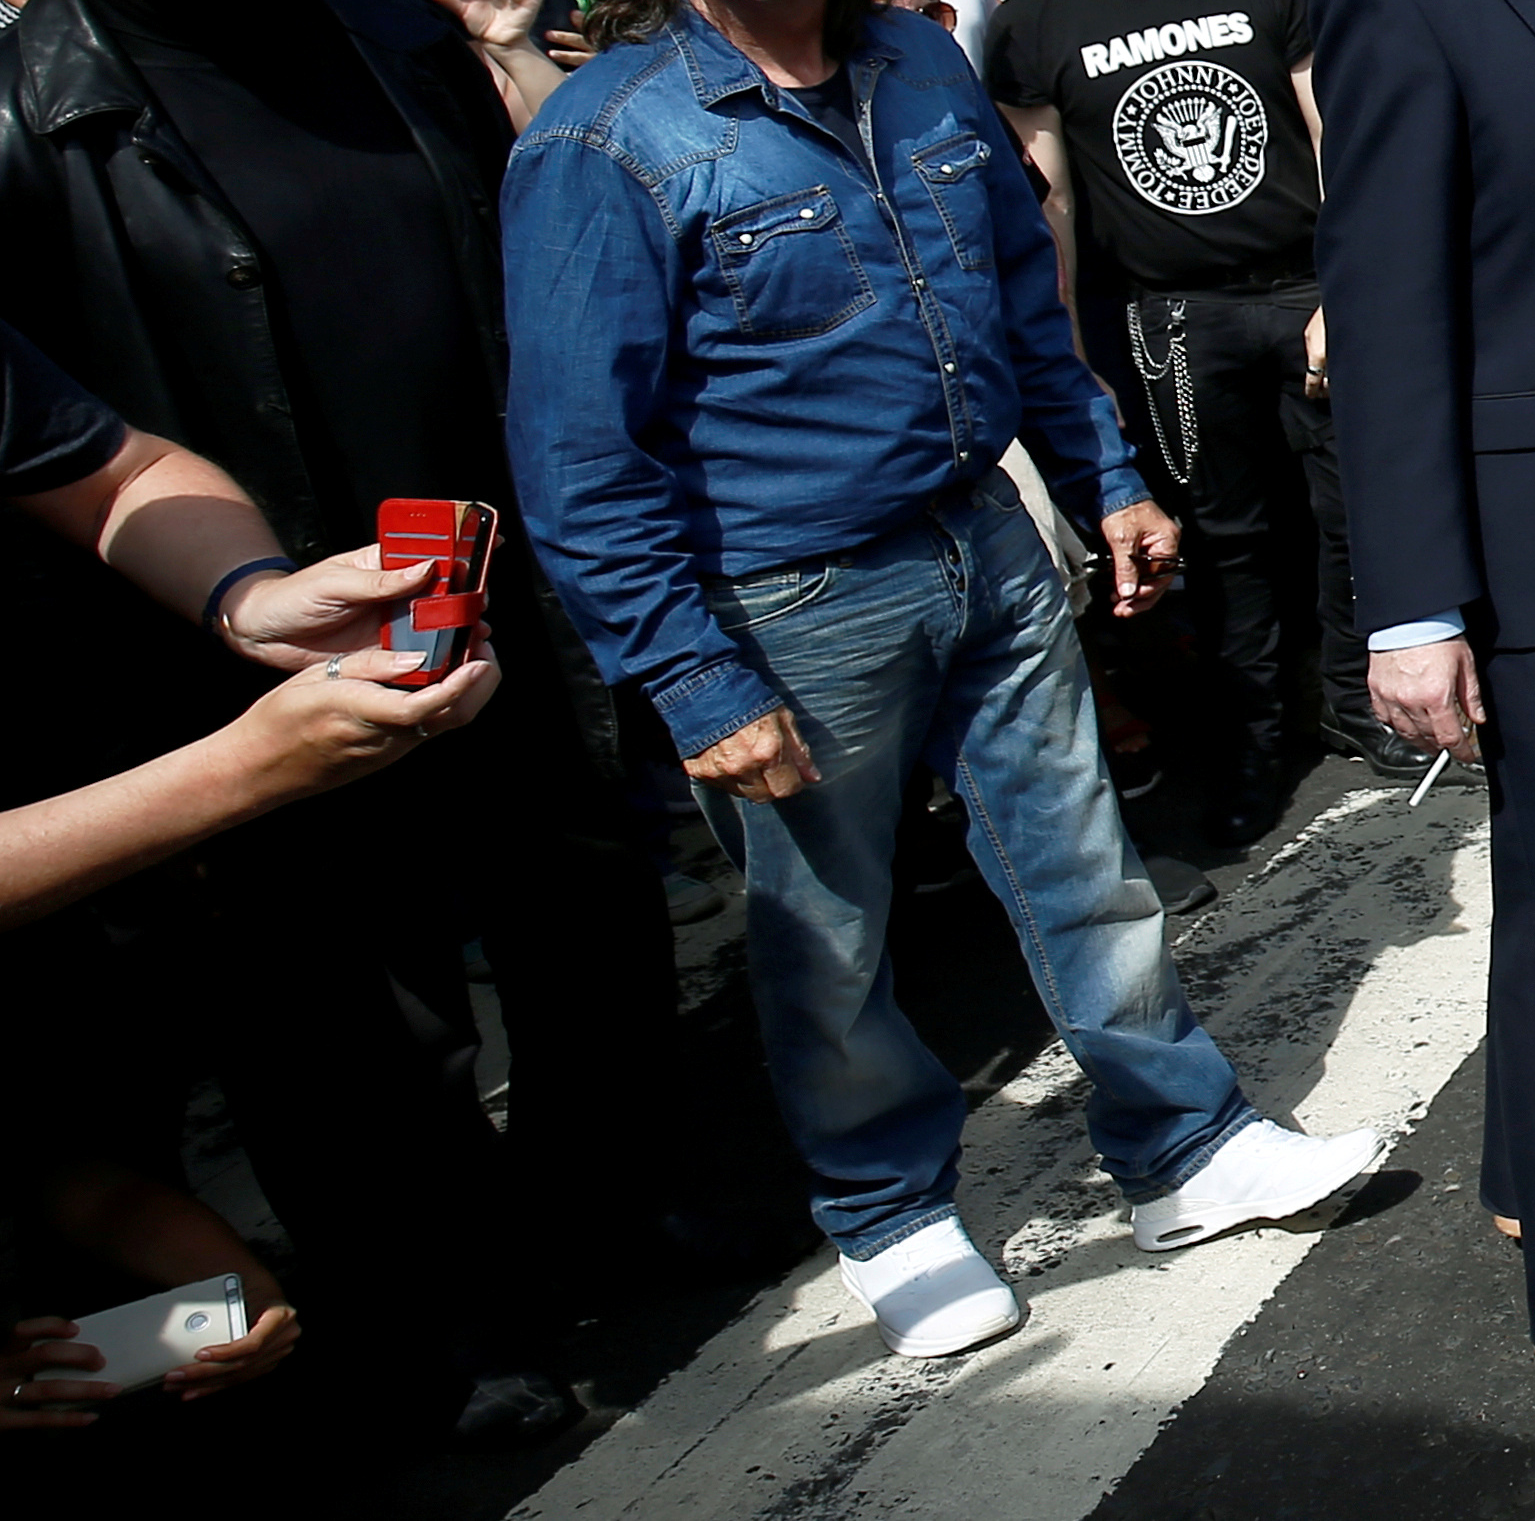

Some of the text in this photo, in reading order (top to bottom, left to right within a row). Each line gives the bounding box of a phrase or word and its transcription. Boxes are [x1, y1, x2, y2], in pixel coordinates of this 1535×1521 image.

[1080, 11, 1255, 79] RAMONES
[1135, 65, 1232, 109] JOHNNY
[1232, 89, 1265, 150] JOEY
[1118, 115, 1164, 202] TOMMY
